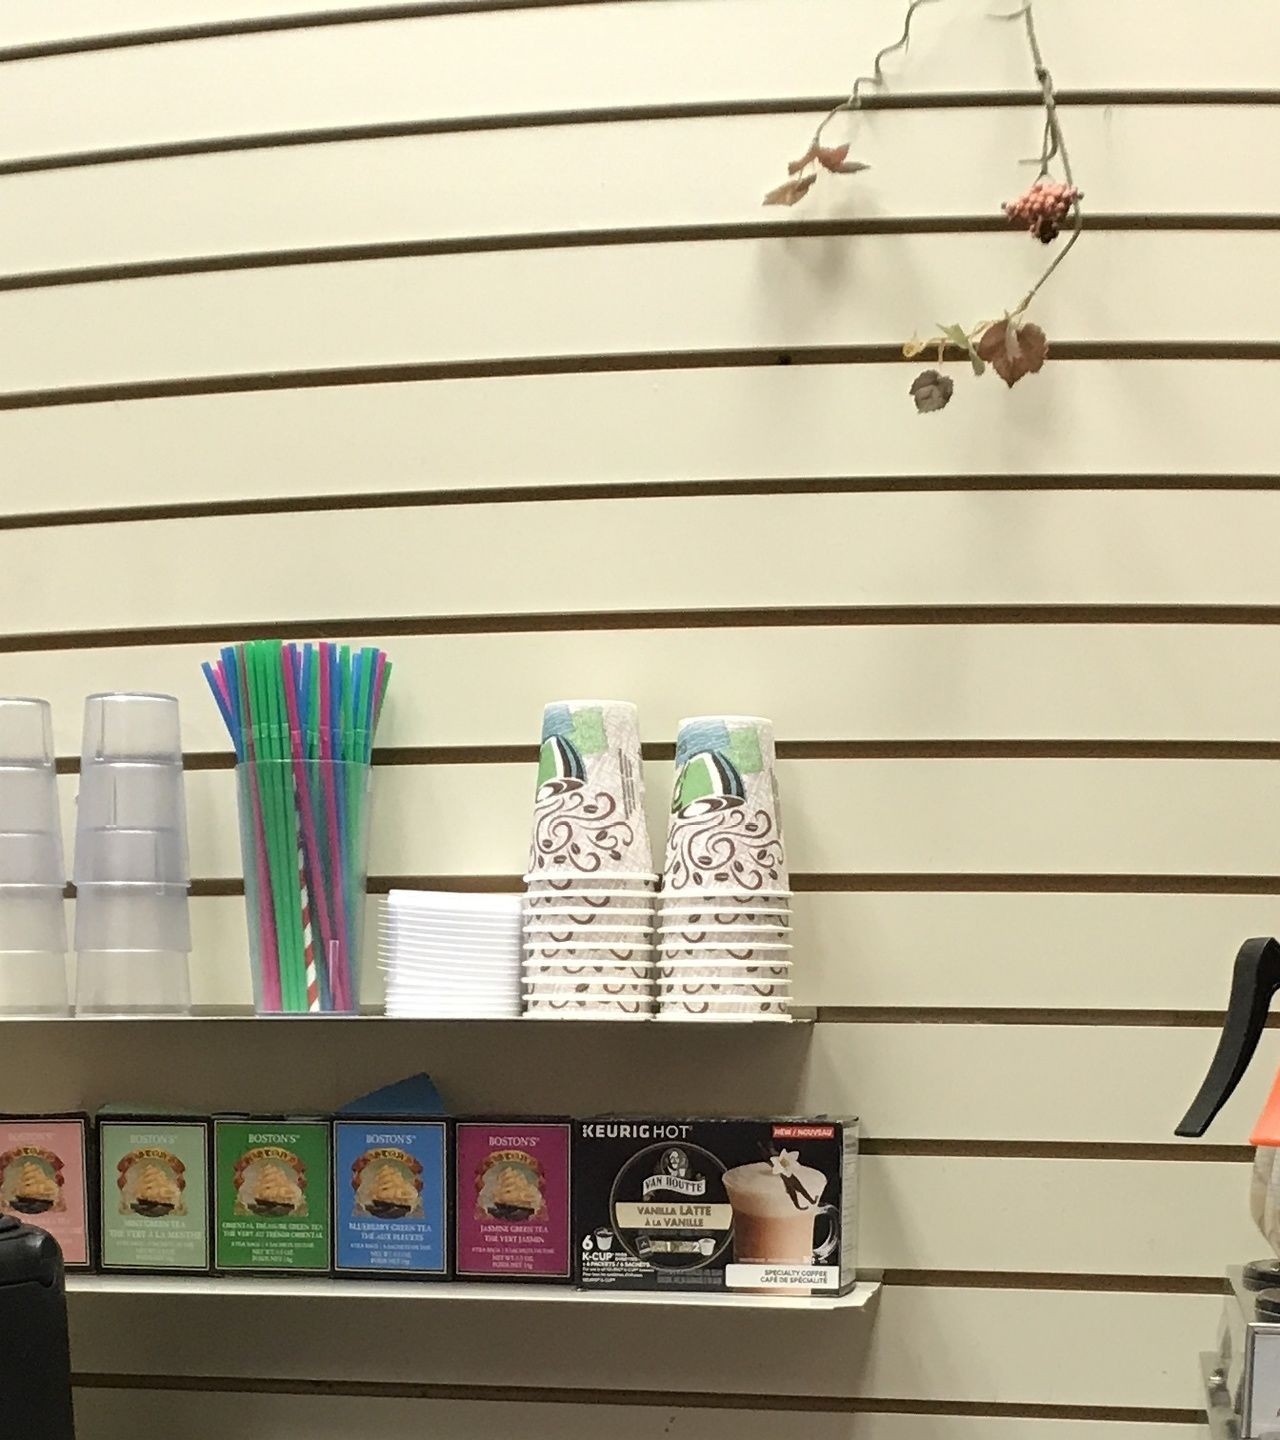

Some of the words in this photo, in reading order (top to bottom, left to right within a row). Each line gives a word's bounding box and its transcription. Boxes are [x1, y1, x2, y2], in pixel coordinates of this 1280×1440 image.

[582, 1124, 650, 1138] KEURIG
[774, 1127, 791, 1136] NEW
[797, 1128, 832, 1137] NOUVEAU
[248, 1133, 297, 1144] BOSTON'S
[366, 1134, 413, 1145] BOSTON'S
[489, 1136, 537, 1147] BOSTON'S
[645, 1177, 663, 1190] VAN
[665, 1176, 703, 1193] HOUTTE
[637, 1206, 677, 1216] VANILLA
[679, 1206, 711, 1216] LATTE
[222, 1222, 254, 1230] ORIENTAL
[288, 1223, 309, 1231] GREEN
[311, 1223, 323, 1231] TEA
[663, 1217, 704, 1227] VANILLE
[417, 1223, 432, 1232] TEA
[480, 1225, 509, 1233] JASMINE
[510, 1225, 533, 1233] GREEN
[535, 1225, 549, 1233] TEA
[291, 1231, 323, 1239] ORIENTAL
[582, 1234, 594, 1250] 6
[582, 1252, 613, 1261] K-CUP
